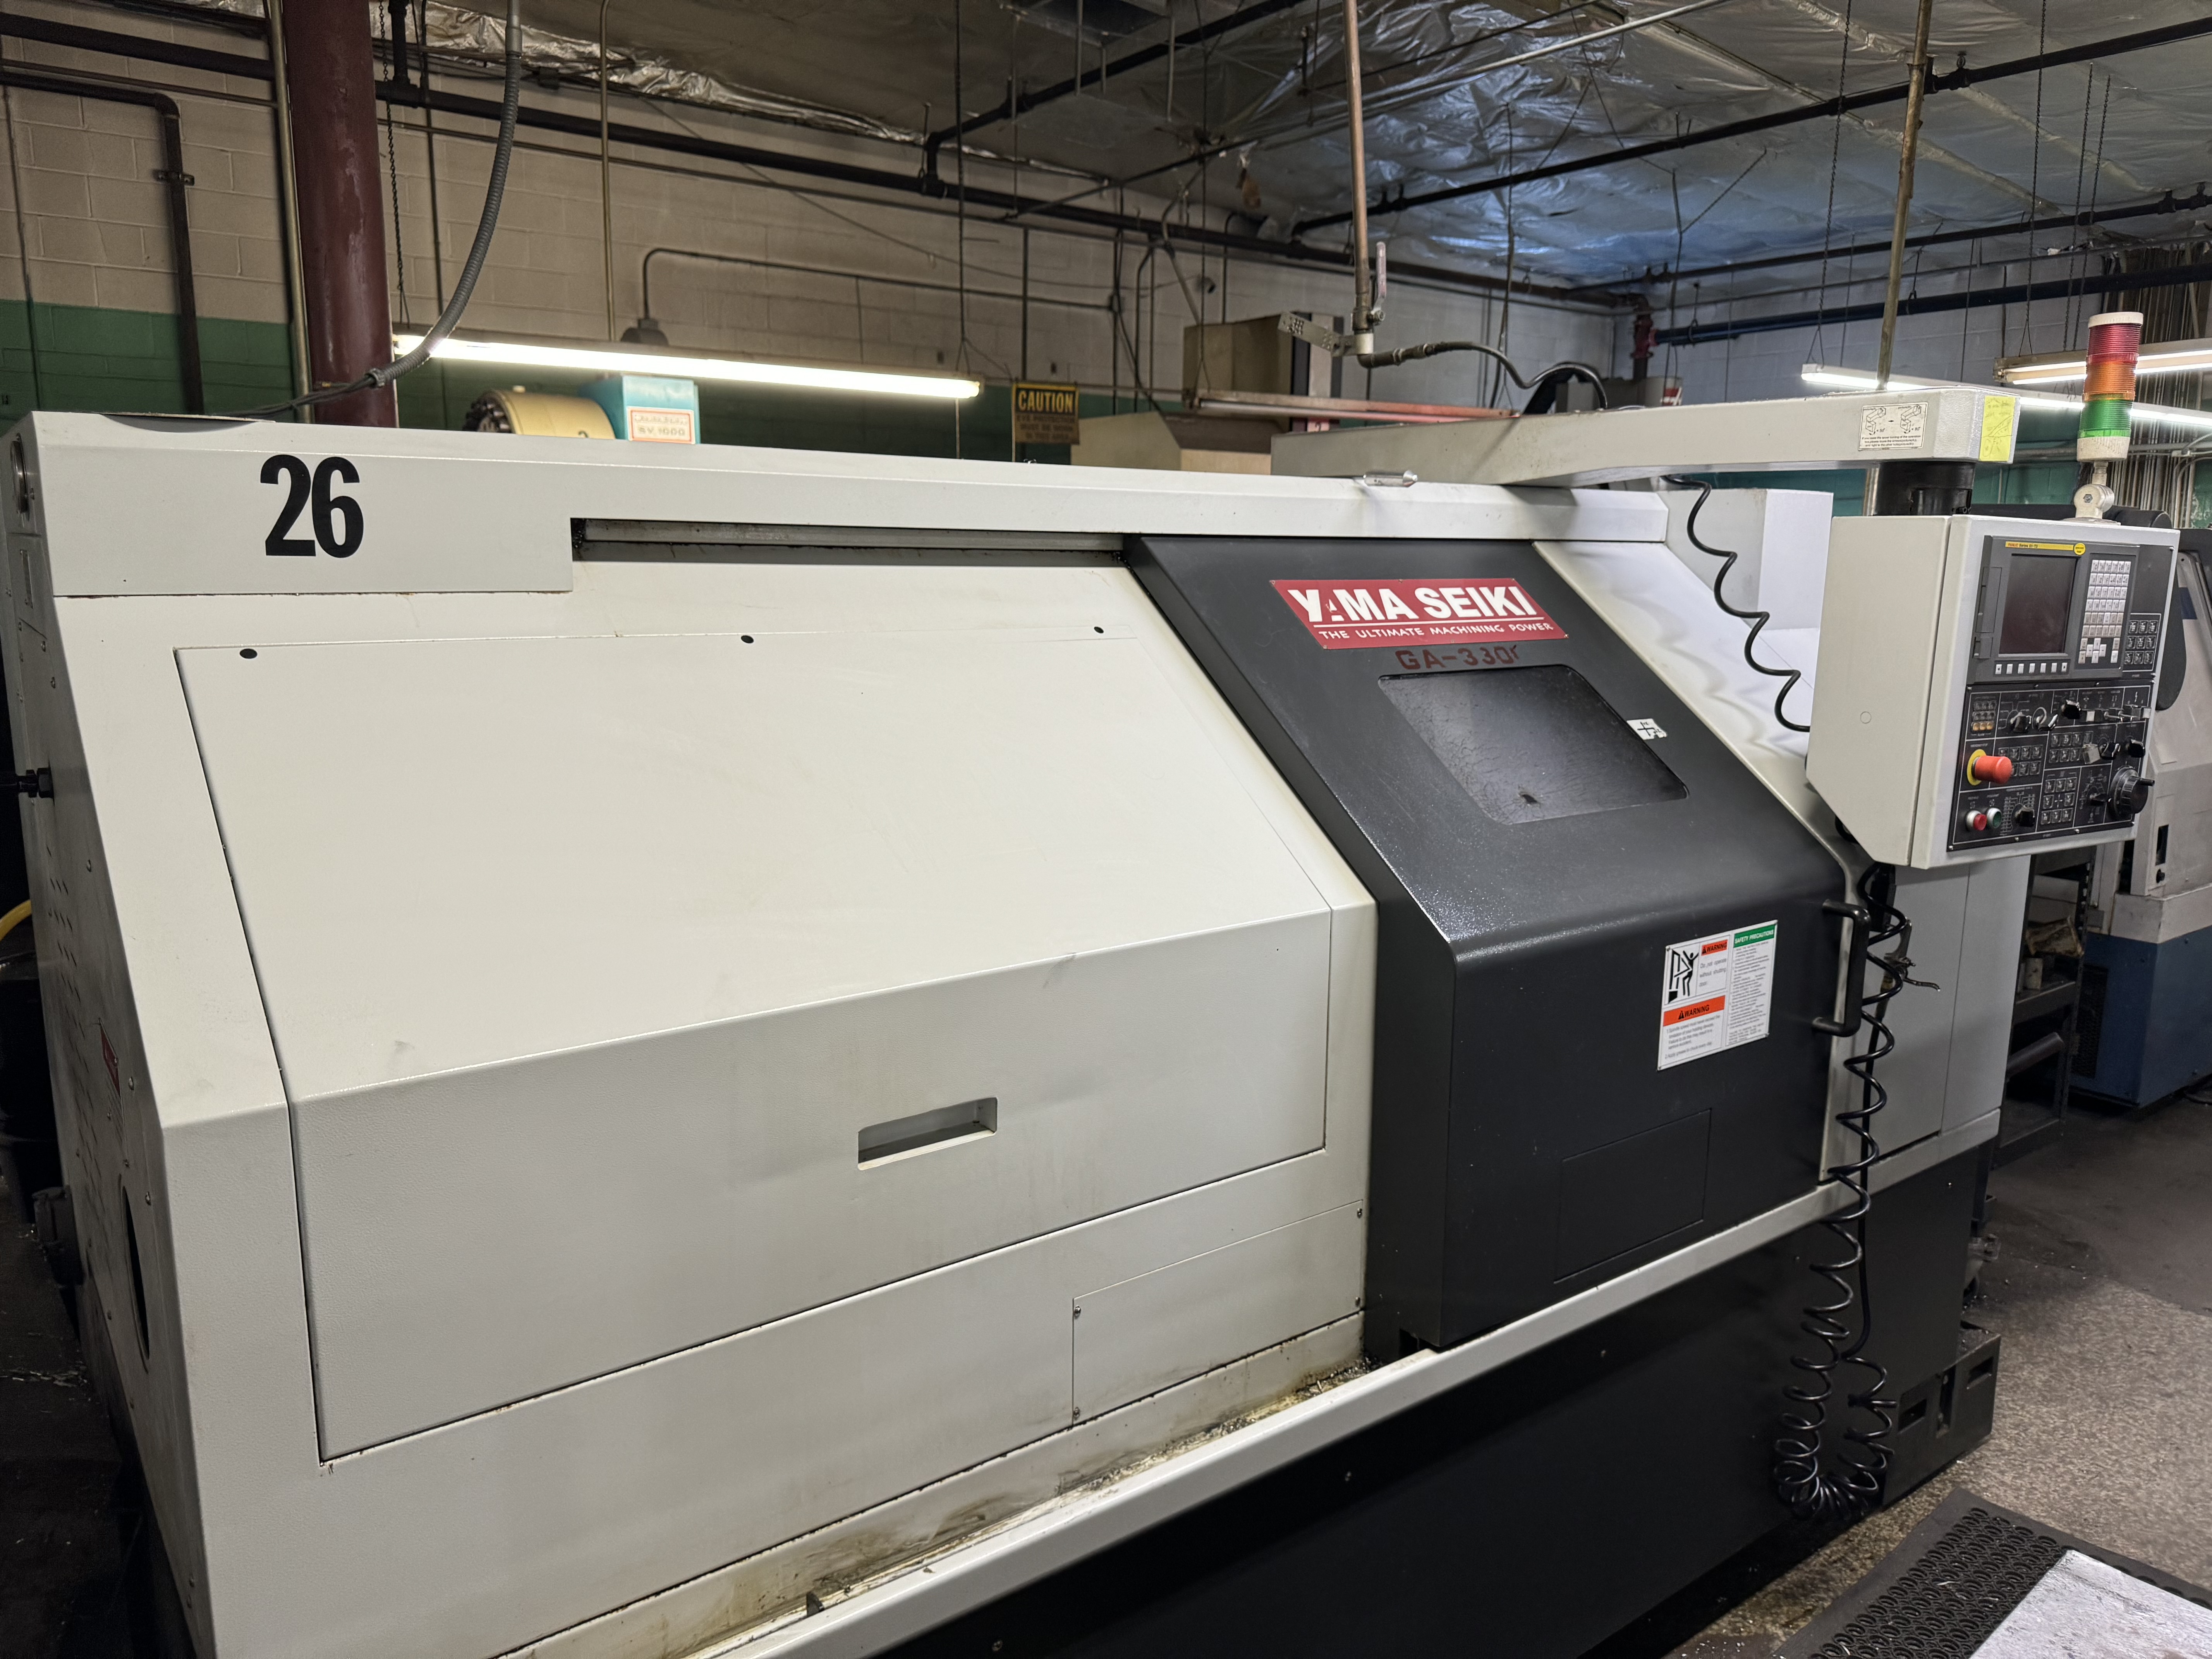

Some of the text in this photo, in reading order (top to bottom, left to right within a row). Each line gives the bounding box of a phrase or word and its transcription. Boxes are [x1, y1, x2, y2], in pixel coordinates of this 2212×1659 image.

[1018, 391, 1073, 413] CAUTION
[260, 454, 364, 558] 26
[1415, 586, 1537, 618] SEIKI
[1319, 623, 1554, 639] THE ULTIMATE MACHINING POWER
[1735, 929, 1774, 944] SAFETY PRECAUTIONS
[1707, 942, 1727, 952] WARNING
[1685, 1005, 1709, 1017] WARNING
